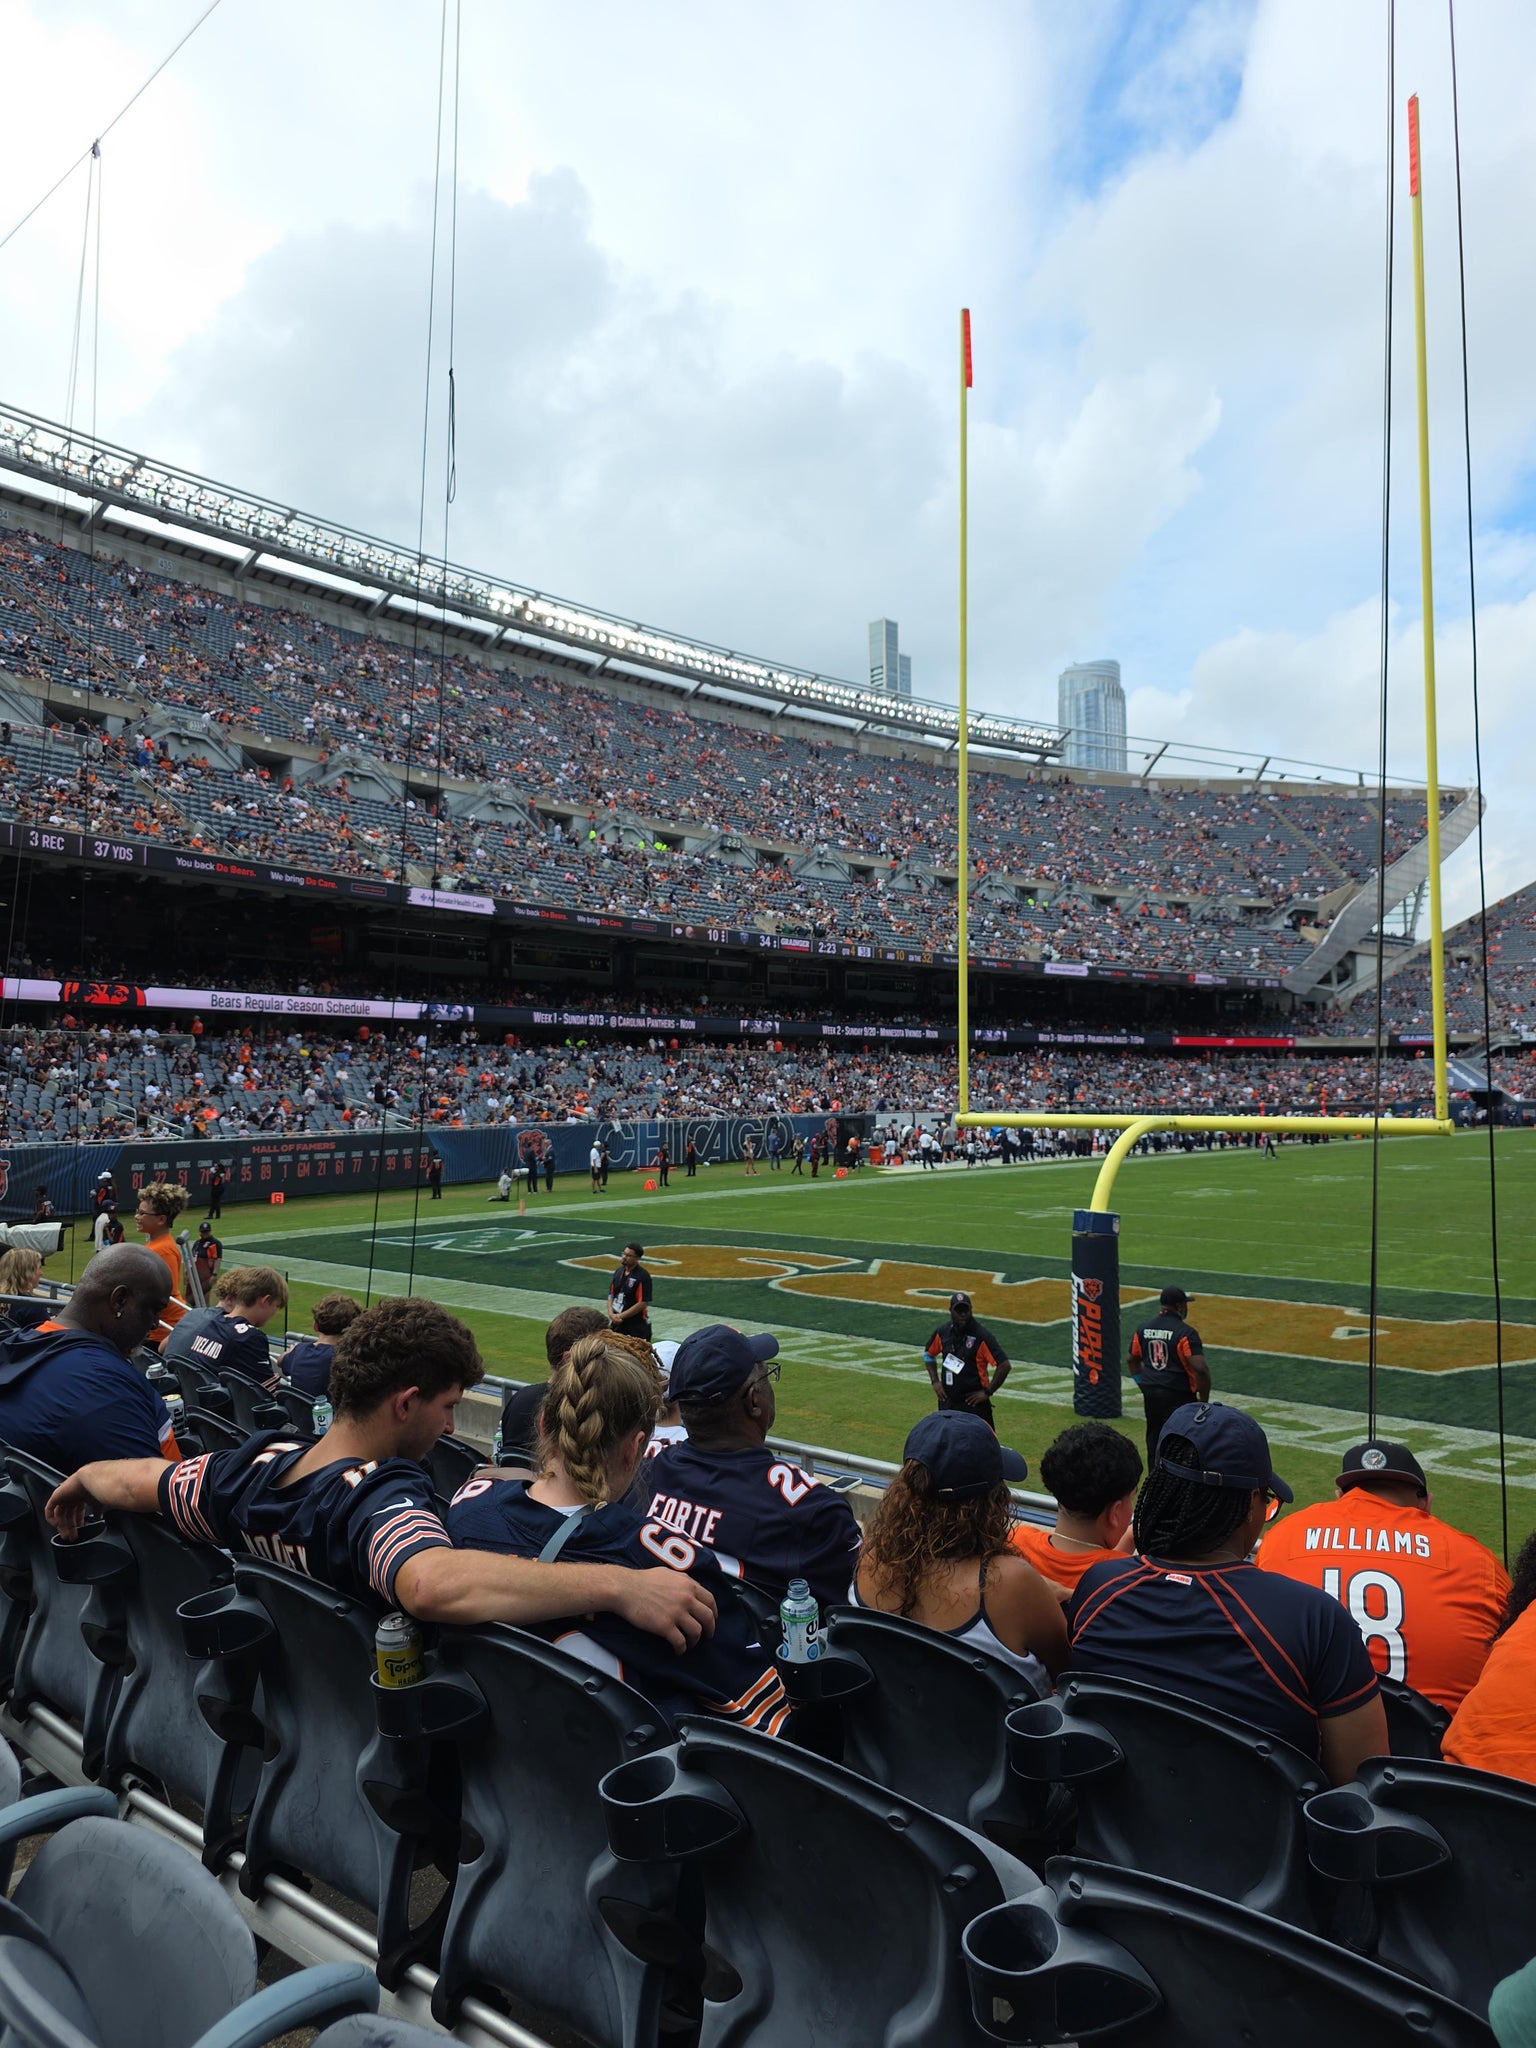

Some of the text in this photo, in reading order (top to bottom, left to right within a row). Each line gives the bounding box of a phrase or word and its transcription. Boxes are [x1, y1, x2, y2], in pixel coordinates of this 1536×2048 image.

[29, 830, 65, 851] 3 REC
[94, 840, 134, 861] 37 YDS
[176, 856, 257, 877] You back Da Bears.
[269, 870, 338, 889] We bring Da Care.
[707, 928, 719, 942] 10
[760, 935, 771, 947] 34
[780, 937, 810, 948] GRAINGER
[818, 942, 837, 954] 2:23
[850, 945, 856, 956] 4
[877, 948, 883, 959] 1
[895, 949, 905, 961] 10
[921, 952, 932, 964] 32
[210, 993, 371, 1016] Bears Regular Season Schedule
[589, 1014, 604, 1027] 9/13
[610, 1016, 617, 1028] @
[863, 1027, 876, 1036] 9/20
[252, 1142, 336, 1153] HALL OF FAMERS
[596, 1115, 795, 1168] CHICAGO
[132, 1172, 144, 1190] 81
[178, 1169, 188, 1186] 51
[241, 1165, 252, 1182] 95
[261, 1164, 272, 1180] 89
[282, 1163, 288, 1179] 1
[297, 1162, 311, 1178] GM
[317, 1161, 326, 1176] 21
[335, 1159, 344, 1175] 61
[352, 1158, 362, 1173] 77
[371, 1157, 378, 1172] 7
[386, 1156, 396, 1171] 99
[420, 1154, 429, 1169] 23
[1077, 1297, 1103, 1371] PLAY
[1143, 1328, 1174, 1340] SECURITY
[647, 1493, 723, 1545] FORTE
[1305, 1527, 1431, 1558] WILLIAMS
